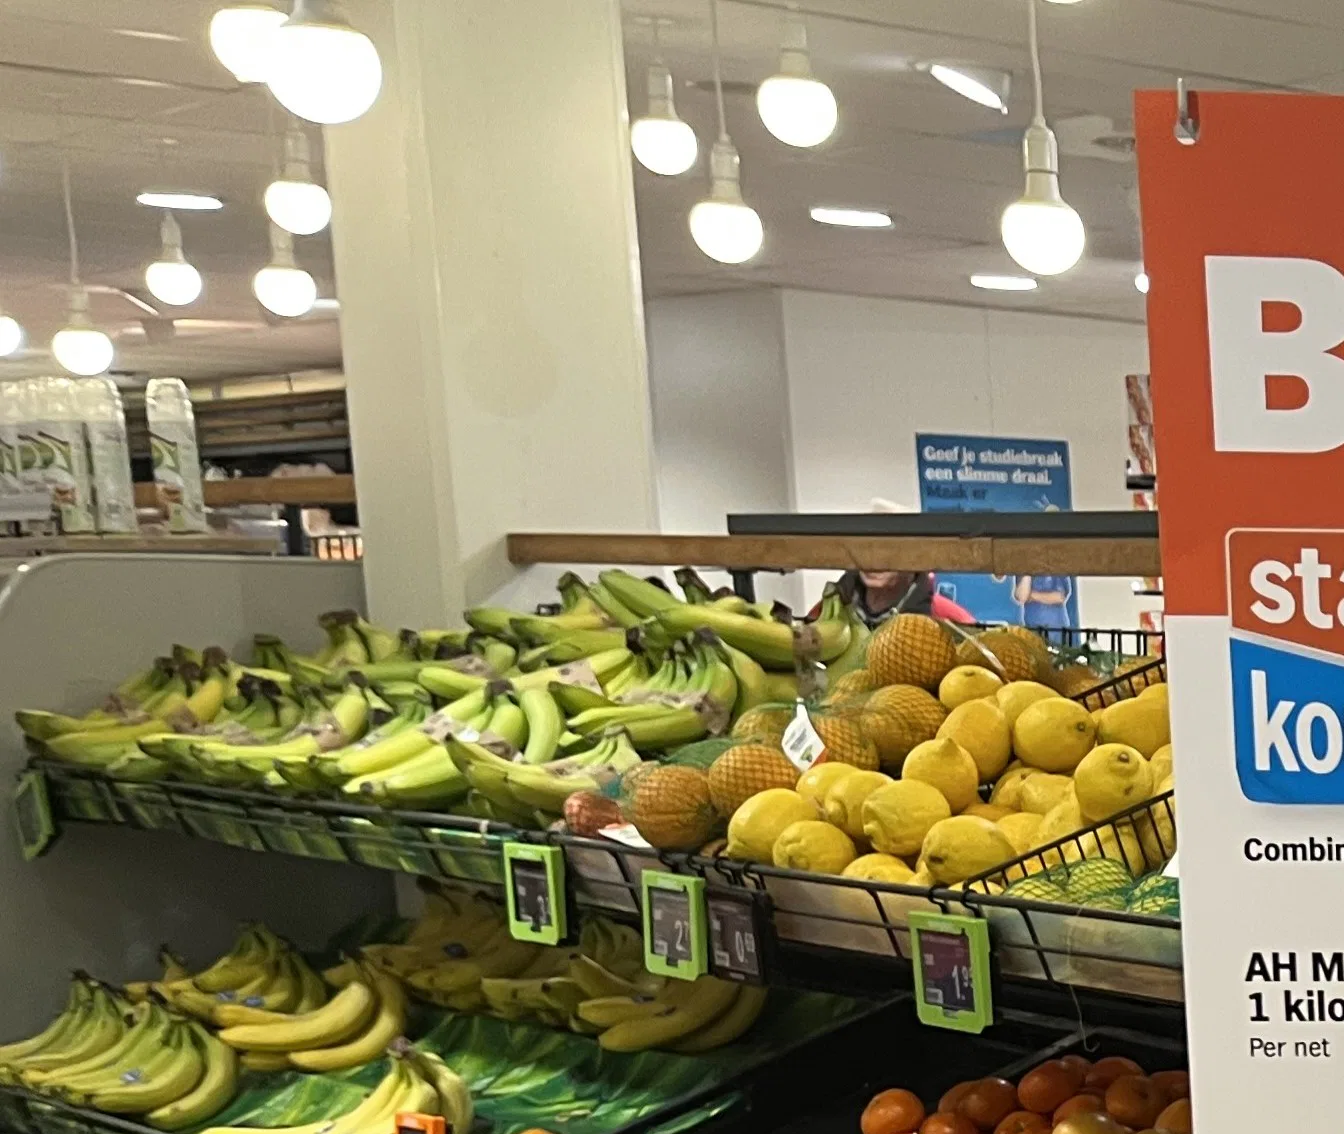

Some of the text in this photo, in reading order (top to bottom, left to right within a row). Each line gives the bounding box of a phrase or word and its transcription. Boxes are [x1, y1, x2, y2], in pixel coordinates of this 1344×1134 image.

[923, 445, 1063, 467] Geef je studiebreak
[925, 467, 1052, 486] een slimme draai.
[1245, 952, 1298, 982] AH
[1249, 992, 1270, 1022] 1
[1250, 1037, 1331, 1058] Per net
